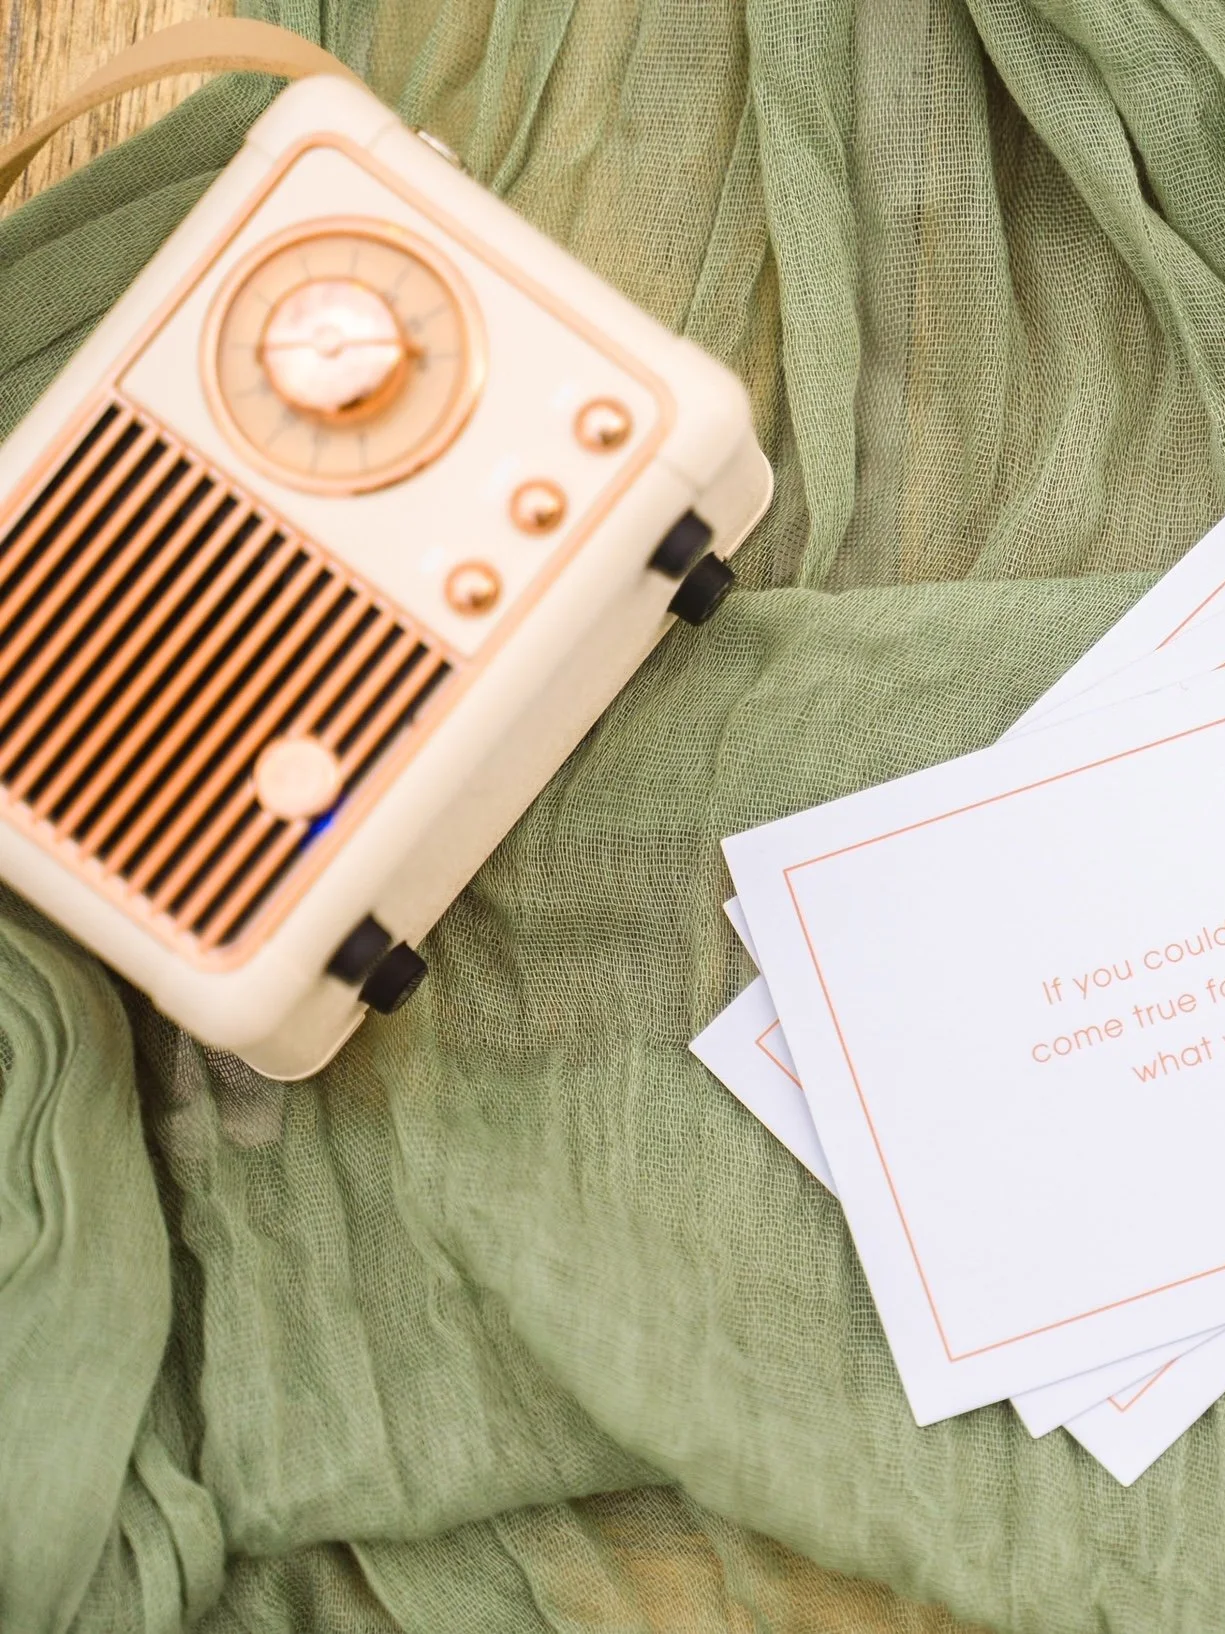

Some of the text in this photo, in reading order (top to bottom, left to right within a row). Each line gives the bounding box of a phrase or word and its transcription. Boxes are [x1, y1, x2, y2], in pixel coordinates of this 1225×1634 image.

[1042, 976, 1063, 1005] If
[1073, 959, 1133, 1000] you
[1031, 1016, 1125, 1064] come
[1132, 992, 1198, 1029] true
[1131, 1036, 1214, 1084] what
